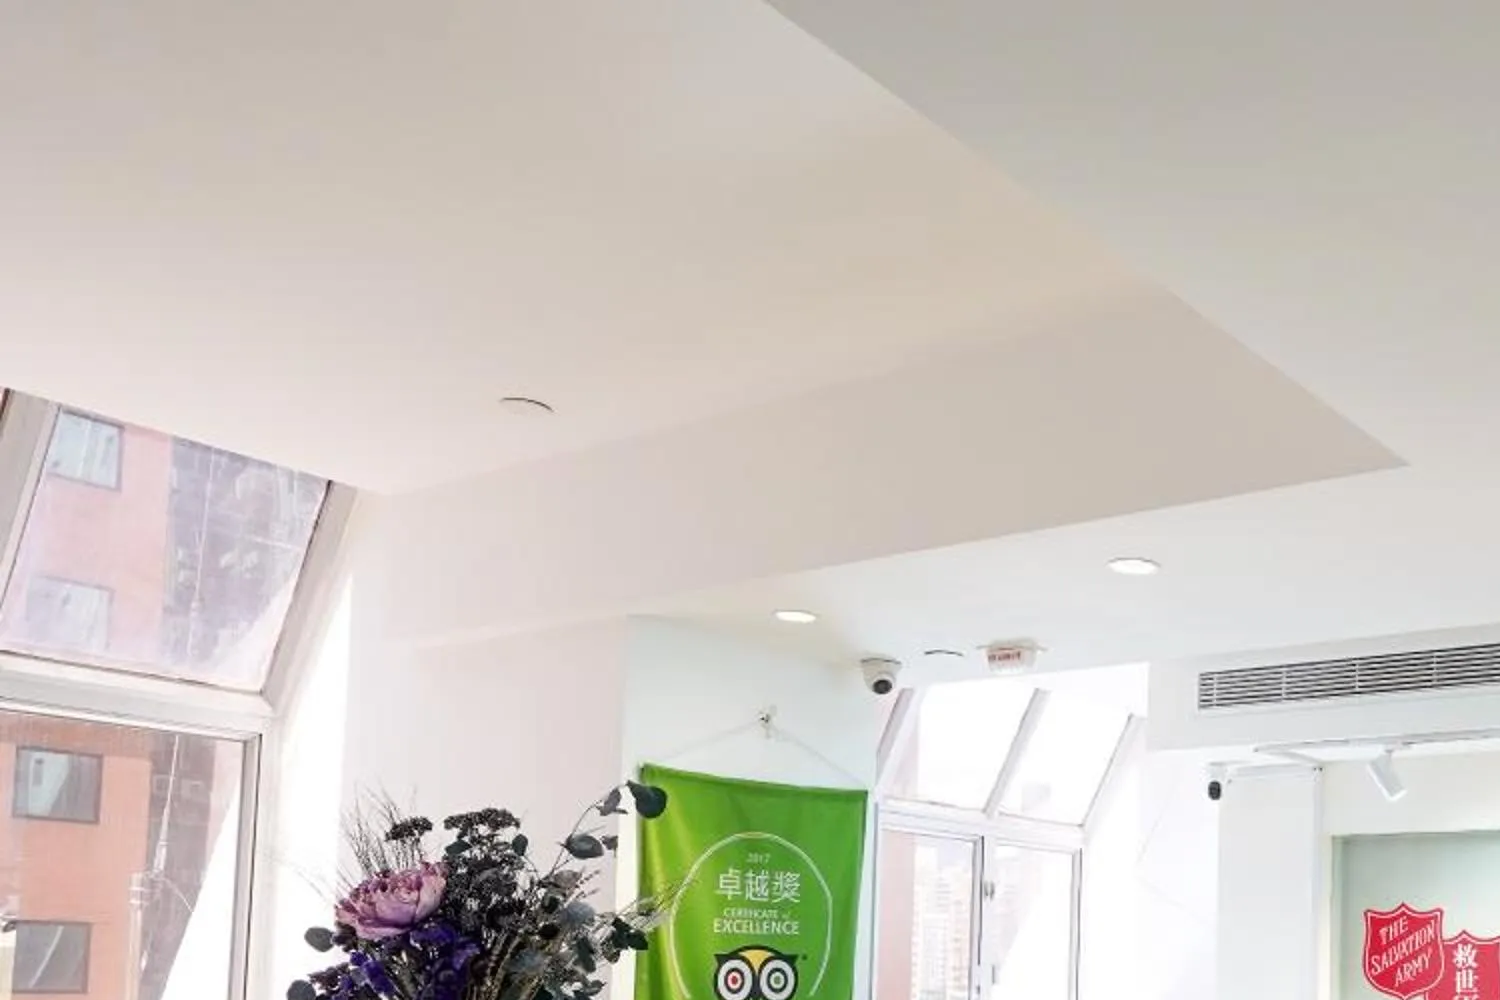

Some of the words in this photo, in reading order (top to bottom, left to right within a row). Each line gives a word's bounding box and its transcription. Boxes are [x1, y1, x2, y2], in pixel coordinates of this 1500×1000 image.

[717, 867, 800, 903] 卓越獎
[713, 918, 800, 935] EXCELLENCE
[1380, 916, 1409, 945] THE
[1371, 919, 1436, 977] SALVATION
[1395, 947, 1433, 988] ARMY
